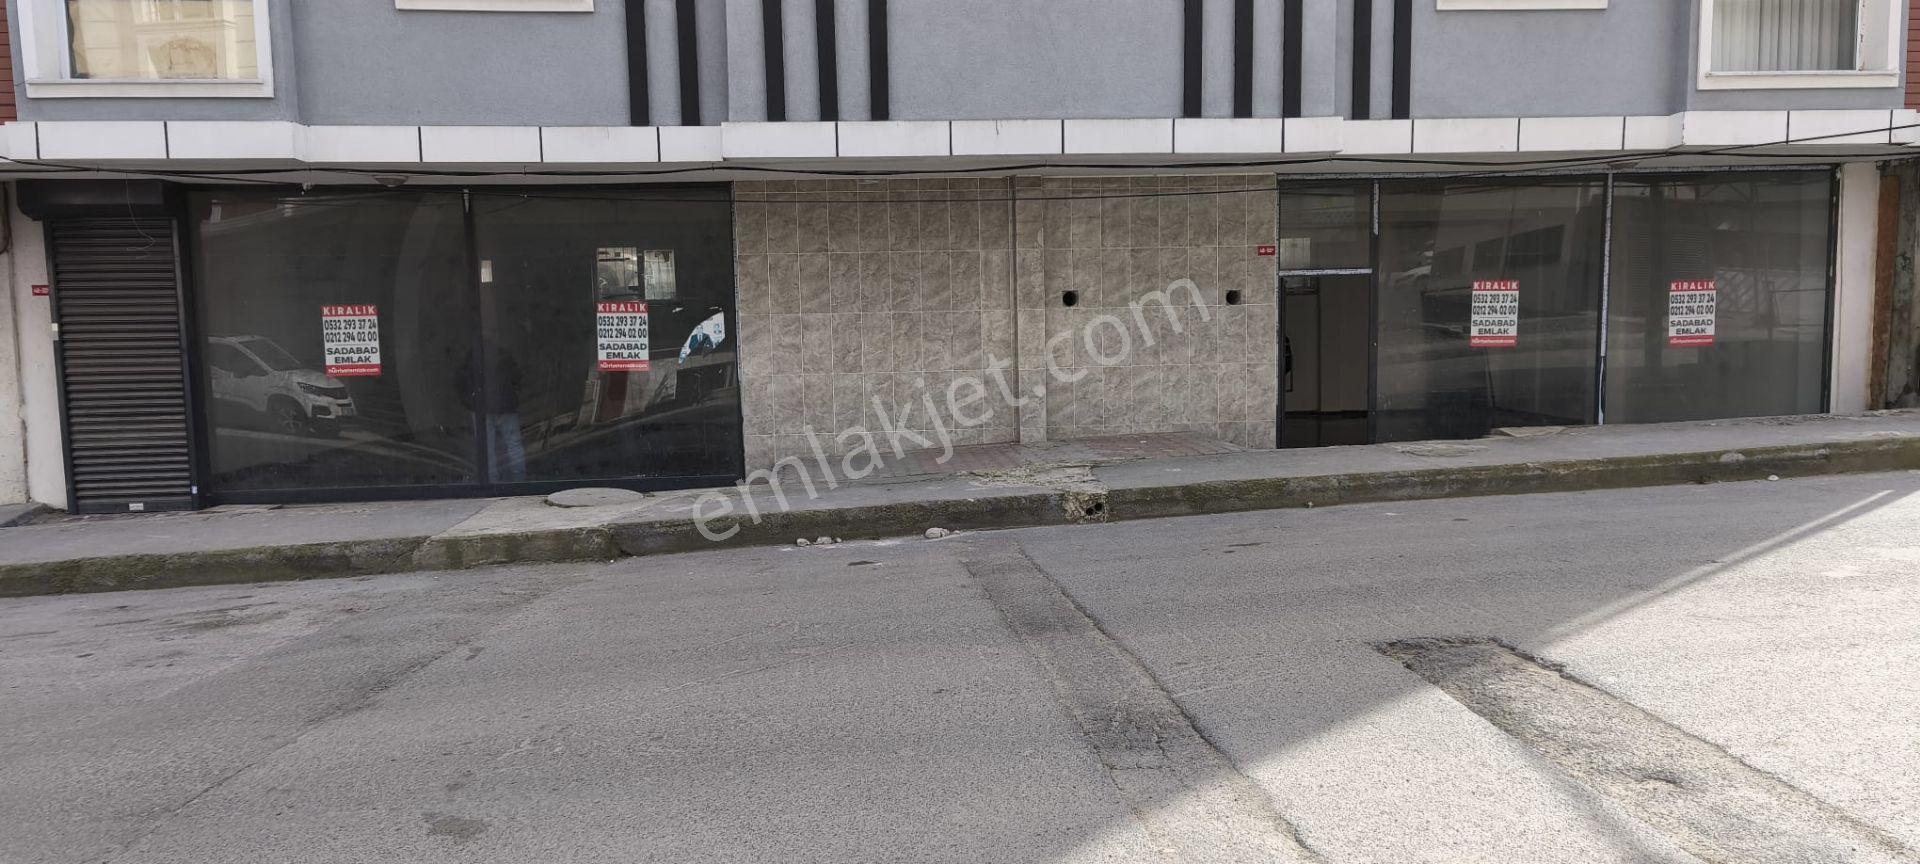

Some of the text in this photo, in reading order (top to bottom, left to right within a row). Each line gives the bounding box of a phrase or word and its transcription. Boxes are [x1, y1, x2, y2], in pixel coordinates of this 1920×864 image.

[1474, 294, 1517, 303] 0532 293 37 24
[1671, 294, 1714, 304] 0532 293 37 24
[1473, 305, 1516, 315] 0212 294 02 00
[1671, 305, 1713, 315] 0212 294 02 00
[324, 319, 376, 330] 0532 293 37 24
[599, 316, 646, 326] 0532 293 37 24
[325, 332, 377, 342] 0212 294 02 00
[599, 329, 647, 338] 0212 294 02 00
[327, 347, 378, 355] SADABAD
